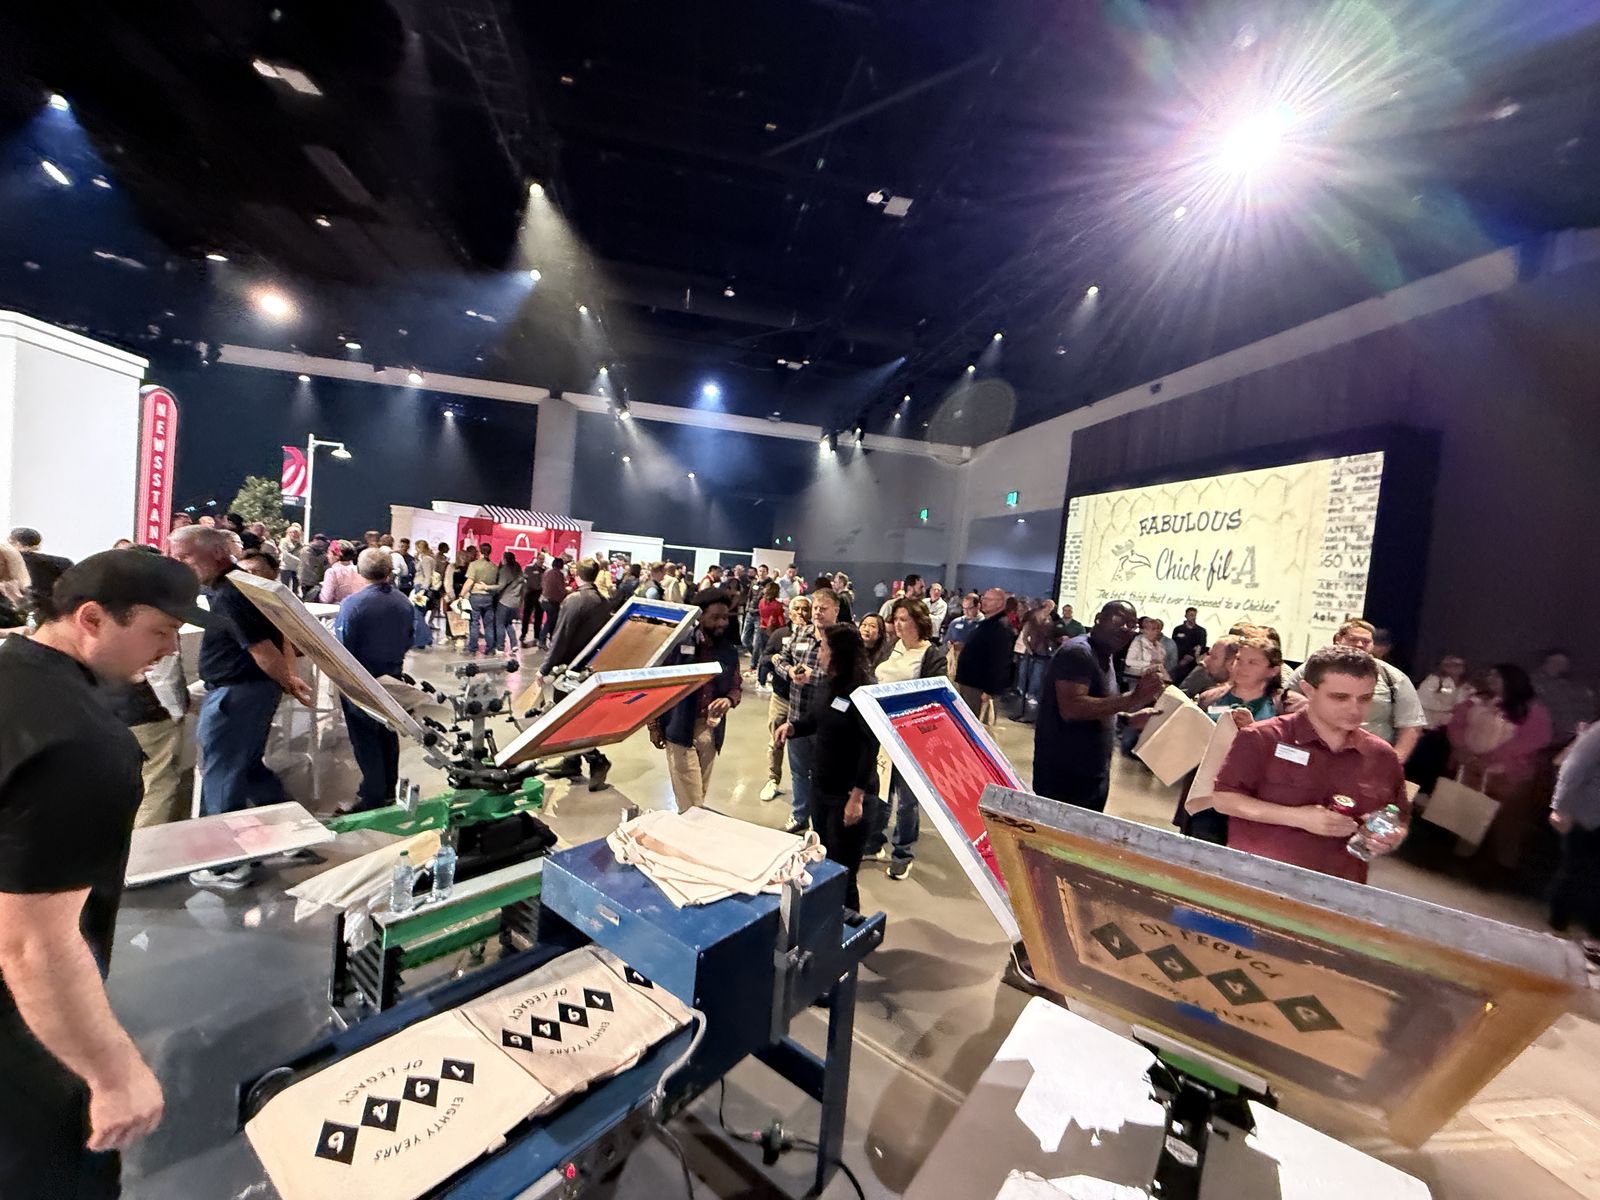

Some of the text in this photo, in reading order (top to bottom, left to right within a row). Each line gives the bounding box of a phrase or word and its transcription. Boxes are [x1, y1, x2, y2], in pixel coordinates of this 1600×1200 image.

[1139, 508, 1242, 536] FABULOUS
[509, 987, 568, 1020] OF LEGACY
[549, 1021, 610, 1055] EIGHTY YEARS
[339, 1059, 423, 1106] OF LEGACY
[373, 1096, 464, 1162] EIGHTY YEARS
